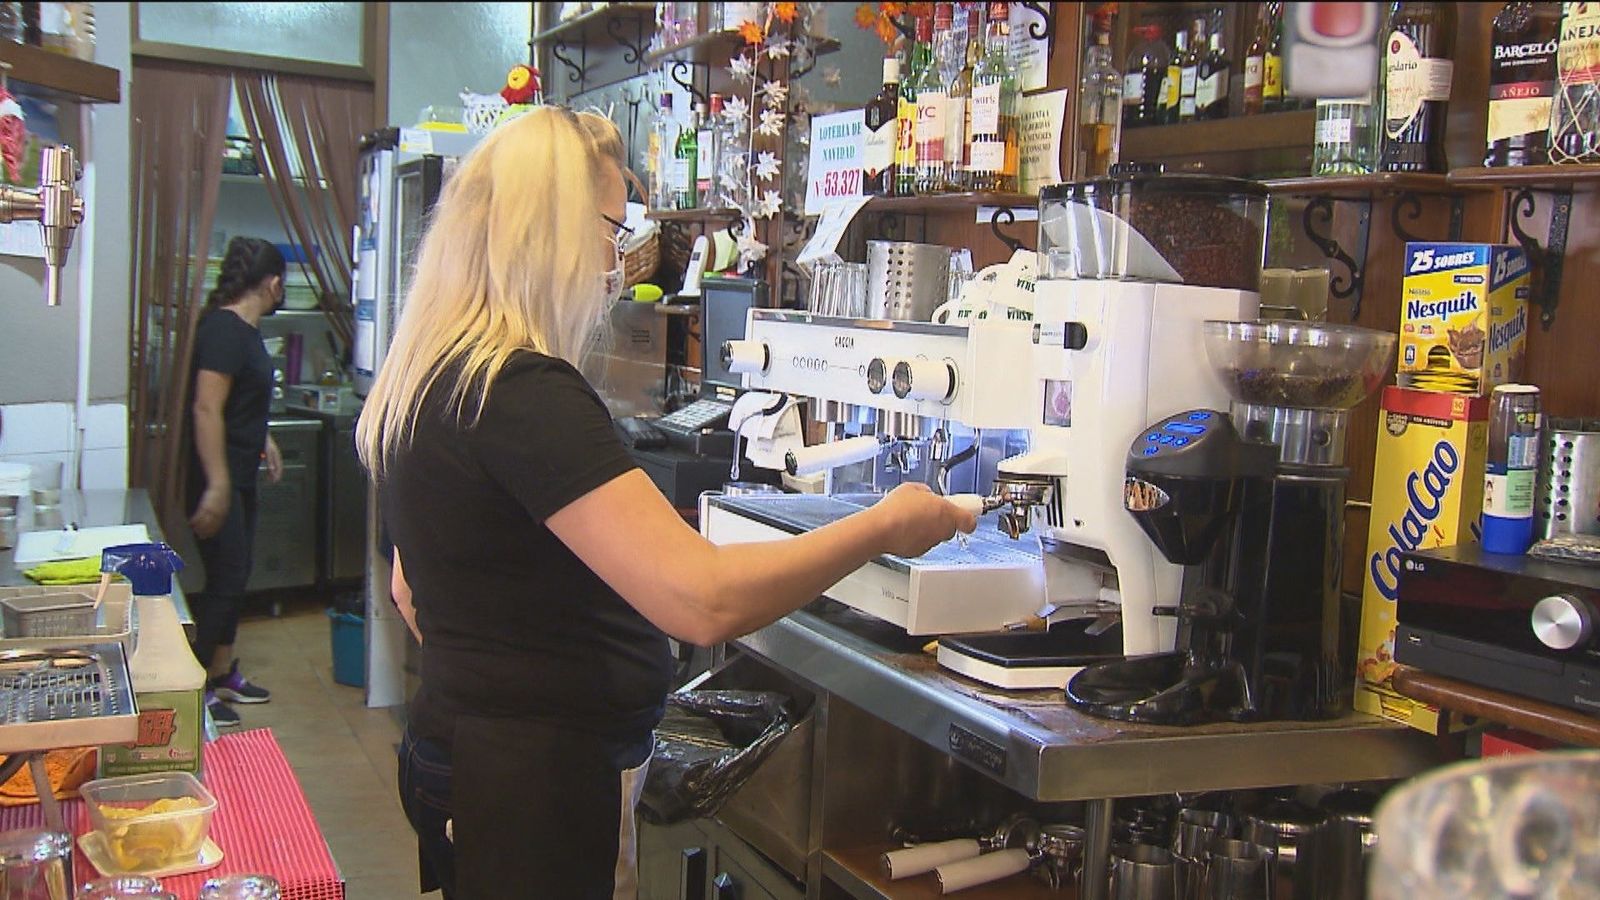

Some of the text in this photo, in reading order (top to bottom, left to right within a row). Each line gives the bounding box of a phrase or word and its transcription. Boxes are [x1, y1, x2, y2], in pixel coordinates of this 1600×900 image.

[1494, 38, 1558, 60] BARCELÓ
[1499, 86, 1540, 98] AÑEJO
[851, 121, 862, 136] DE
[823, 144, 856, 160] NAVIDAD
[824, 168, 860, 197] 53.327
[1410, 249, 1475, 272] 25 SOBRES
[1493, 251, 1509, 286] 25
[1407, 291, 1477, 321] Nesquik
[1489, 305, 1527, 355] Nesquik
[1371, 440, 1459, 600] ColaCao
[1414, 560, 1425, 571] LG
